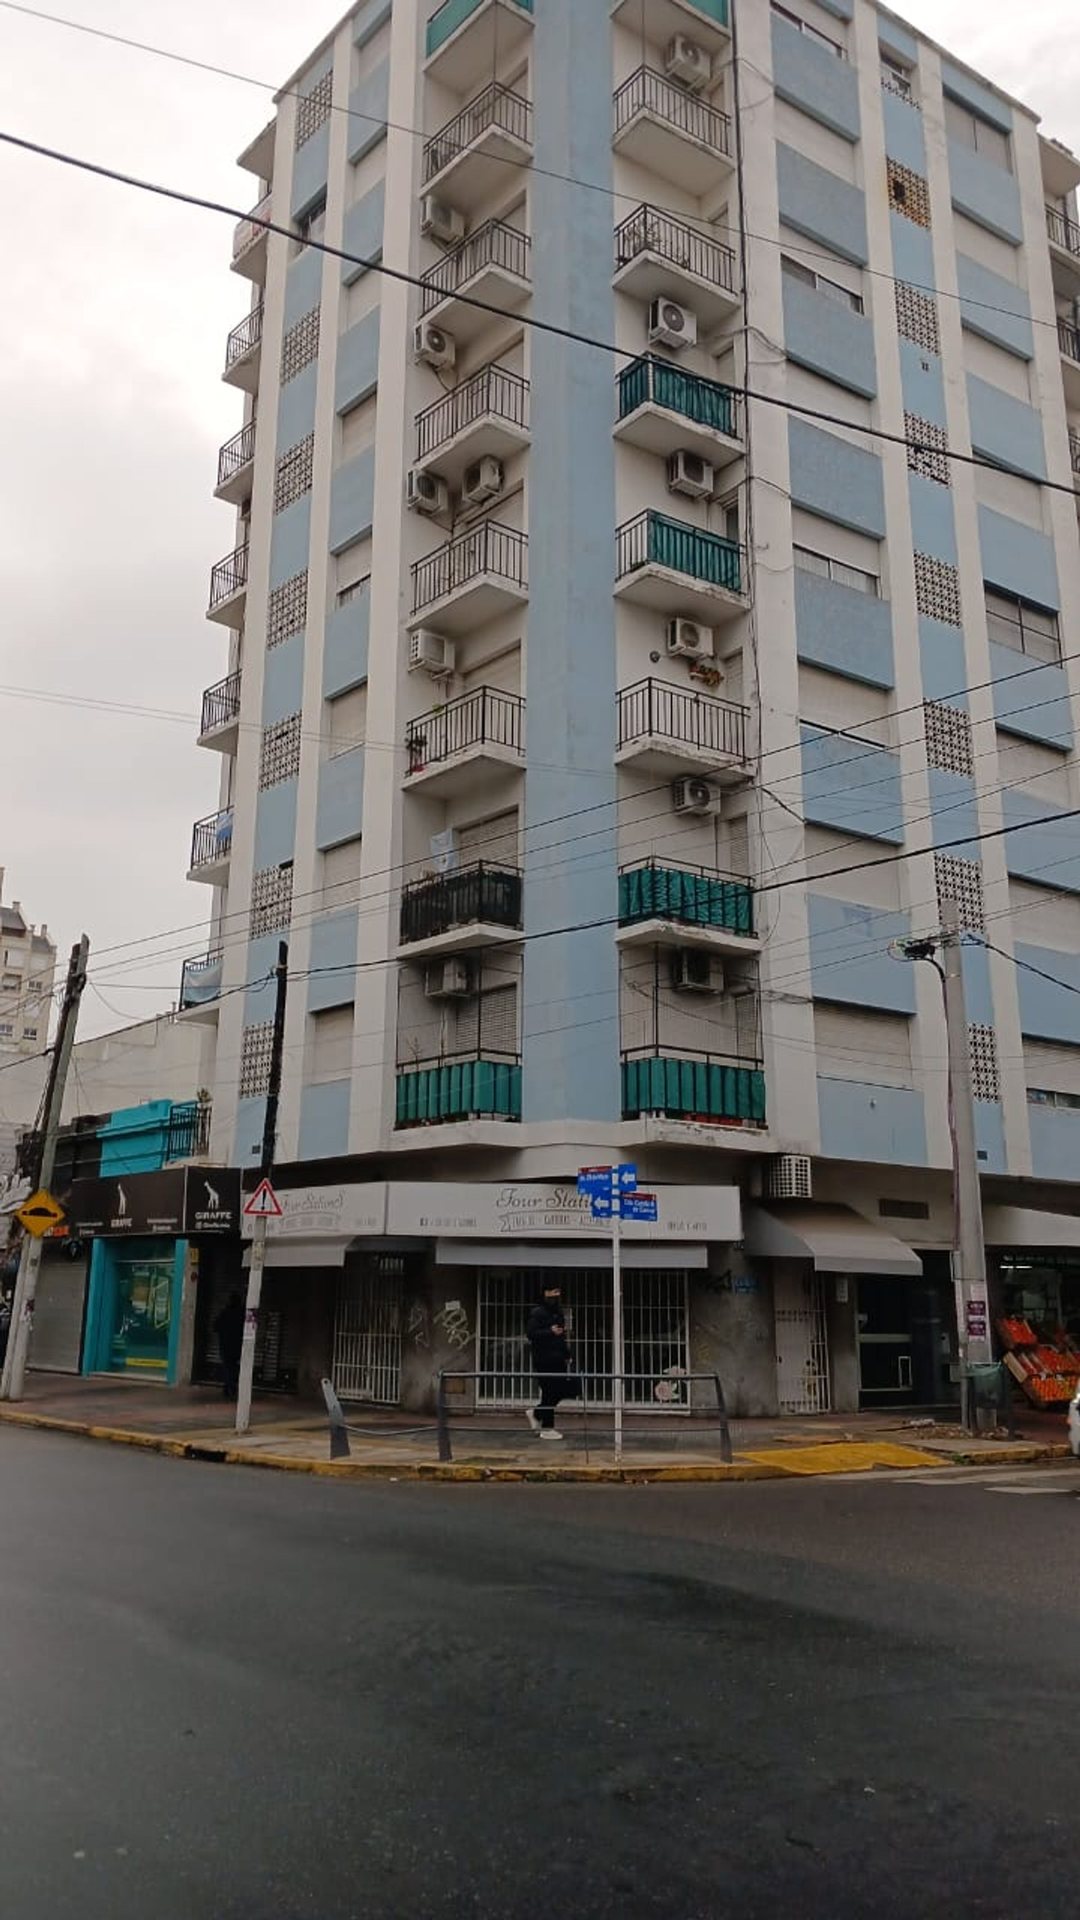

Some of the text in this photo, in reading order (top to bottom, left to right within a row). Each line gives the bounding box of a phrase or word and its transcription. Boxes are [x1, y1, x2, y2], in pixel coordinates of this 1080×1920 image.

[495, 1186, 591, 1209] Four Stati
[194, 1211, 233, 1220] GIRAFFE
